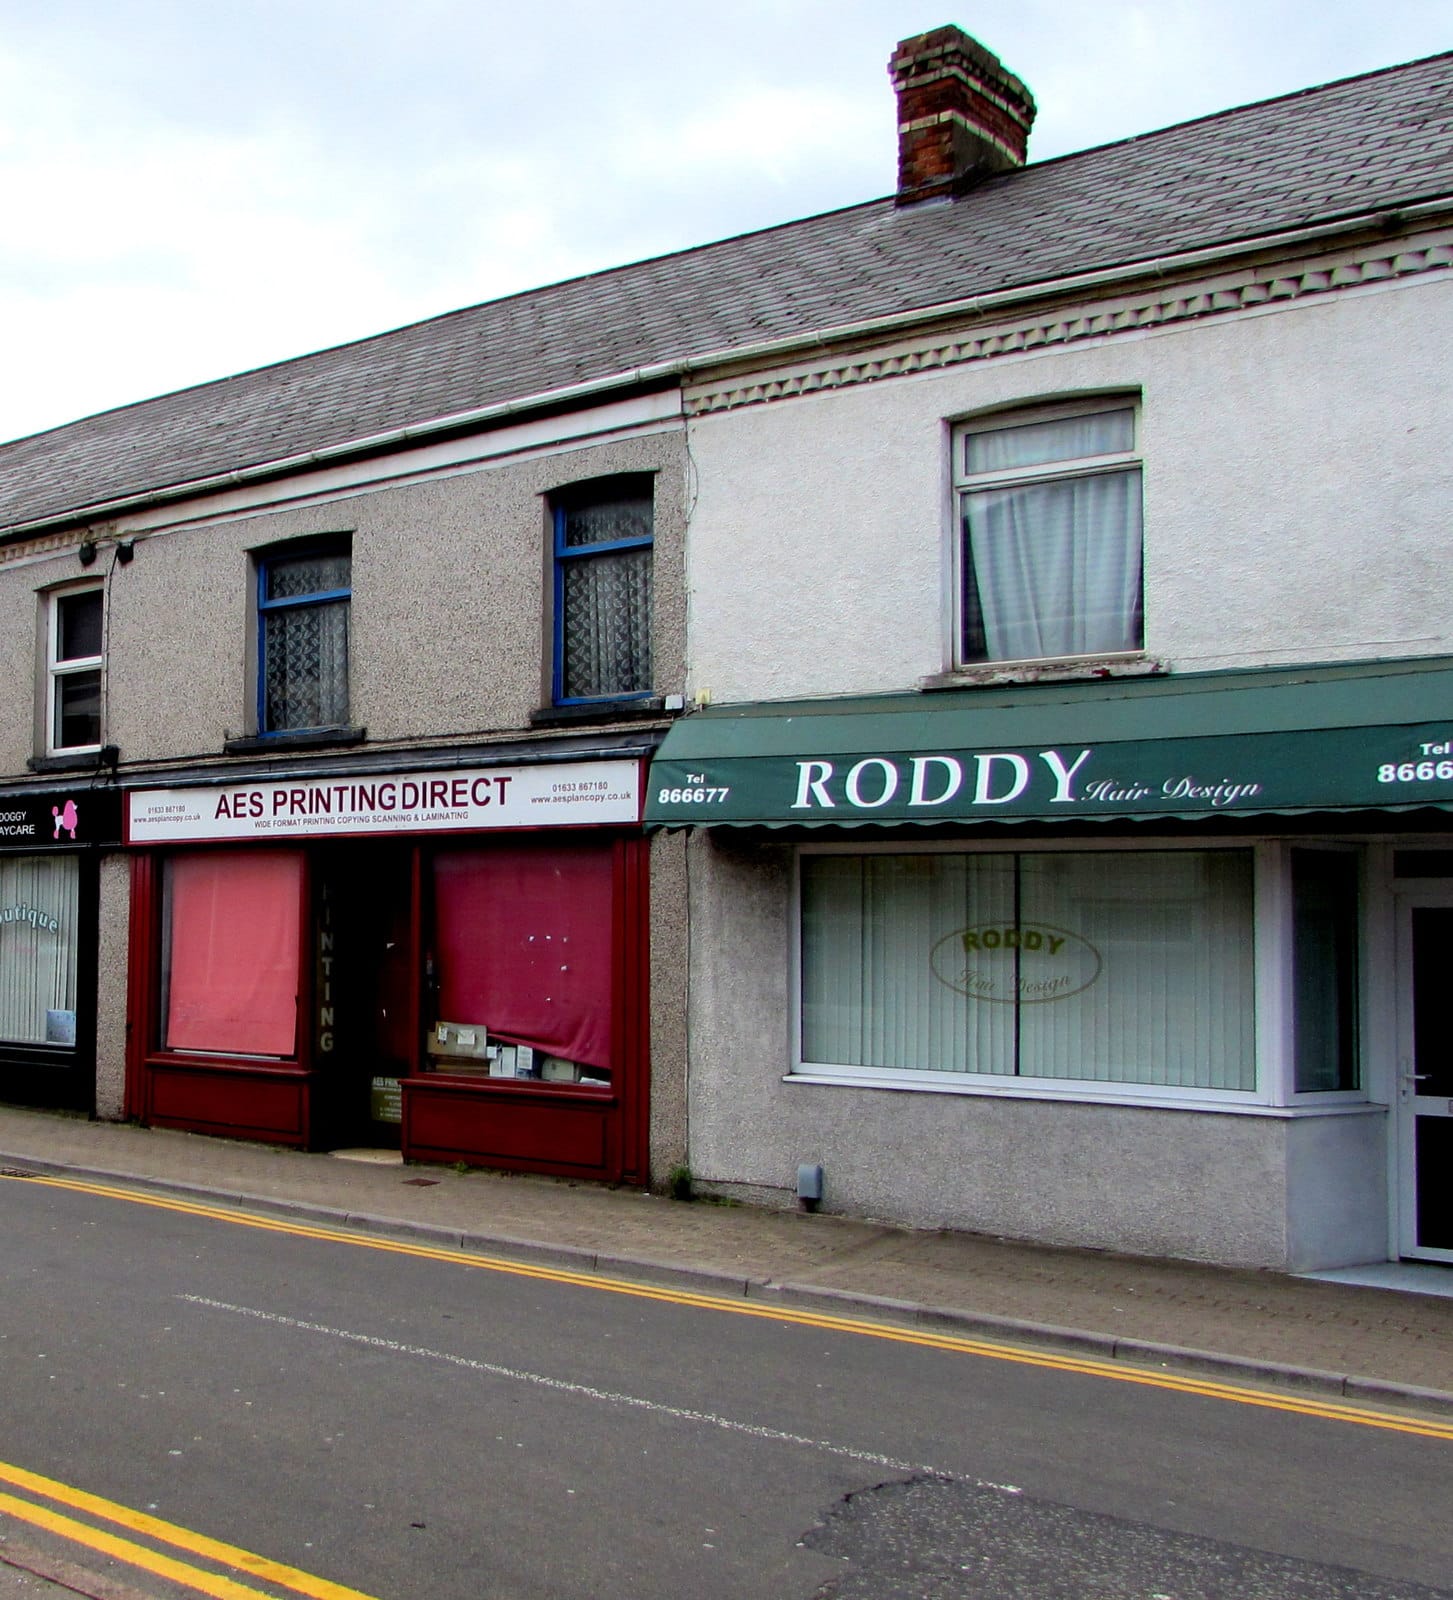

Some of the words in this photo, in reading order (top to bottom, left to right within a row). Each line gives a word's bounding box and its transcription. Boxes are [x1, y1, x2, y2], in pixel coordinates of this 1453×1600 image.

[1419, 741, 1450, 755] Tel
[686, 774, 705, 784] Tel
[790, 750, 1091, 808] RODDY
[1080, 779, 1150, 801] Hair
[1160, 775, 1259, 806] Design
[1377, 761, 1453, 783] 8666
[552, 782, 577, 793] 01633
[578, 781, 608, 792] 867180
[530, 791, 632, 804] www.aesplancopy.co.uk
[658, 788, 729, 803] 866677
[214, 791, 264, 820] AES
[254, 820, 272, 829] WIDE
[272, 818, 302, 827] FORMAT
[303, 816, 336, 826] PRINTING
[337, 815, 370, 824] COPYING
[371, 813, 412, 823] SCANNING
[413, 813, 420, 822] &
[421, 811, 469, 822] LAMINATING
[962, 928, 1065, 956] RODDY
